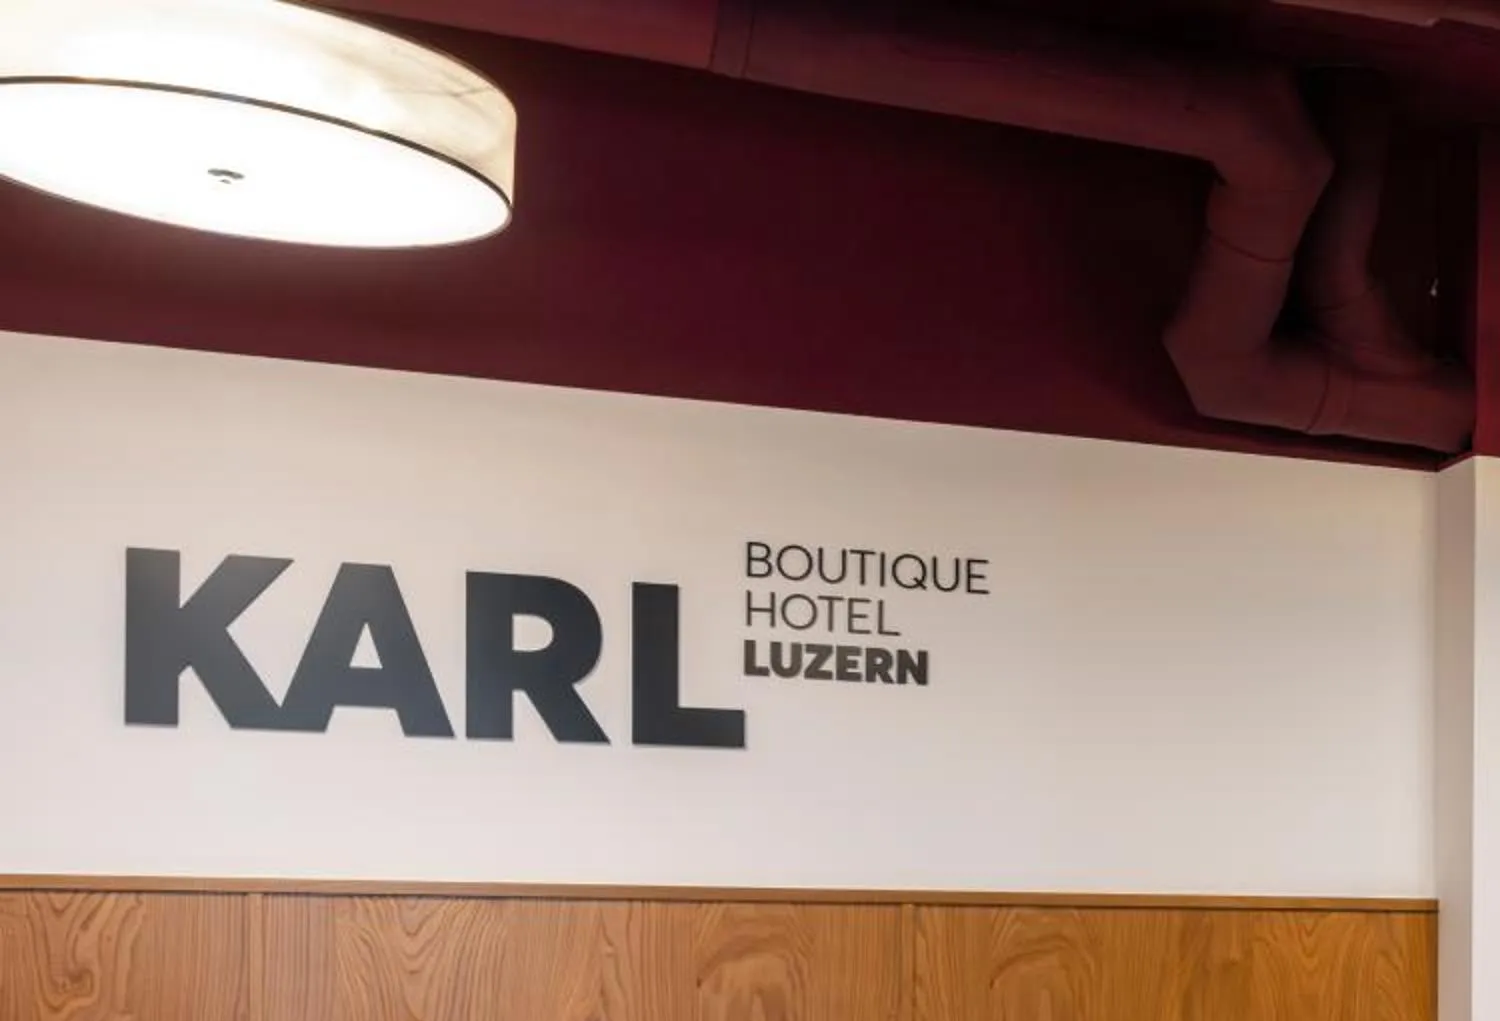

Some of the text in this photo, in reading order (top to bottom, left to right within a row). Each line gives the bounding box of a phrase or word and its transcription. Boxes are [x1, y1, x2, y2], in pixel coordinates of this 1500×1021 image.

[746, 541, 990, 595] BOUTIQUE
[746, 590, 902, 636] HOTEL
[125, 547, 746, 749] KARL
[744, 639, 929, 686] LUZERN
